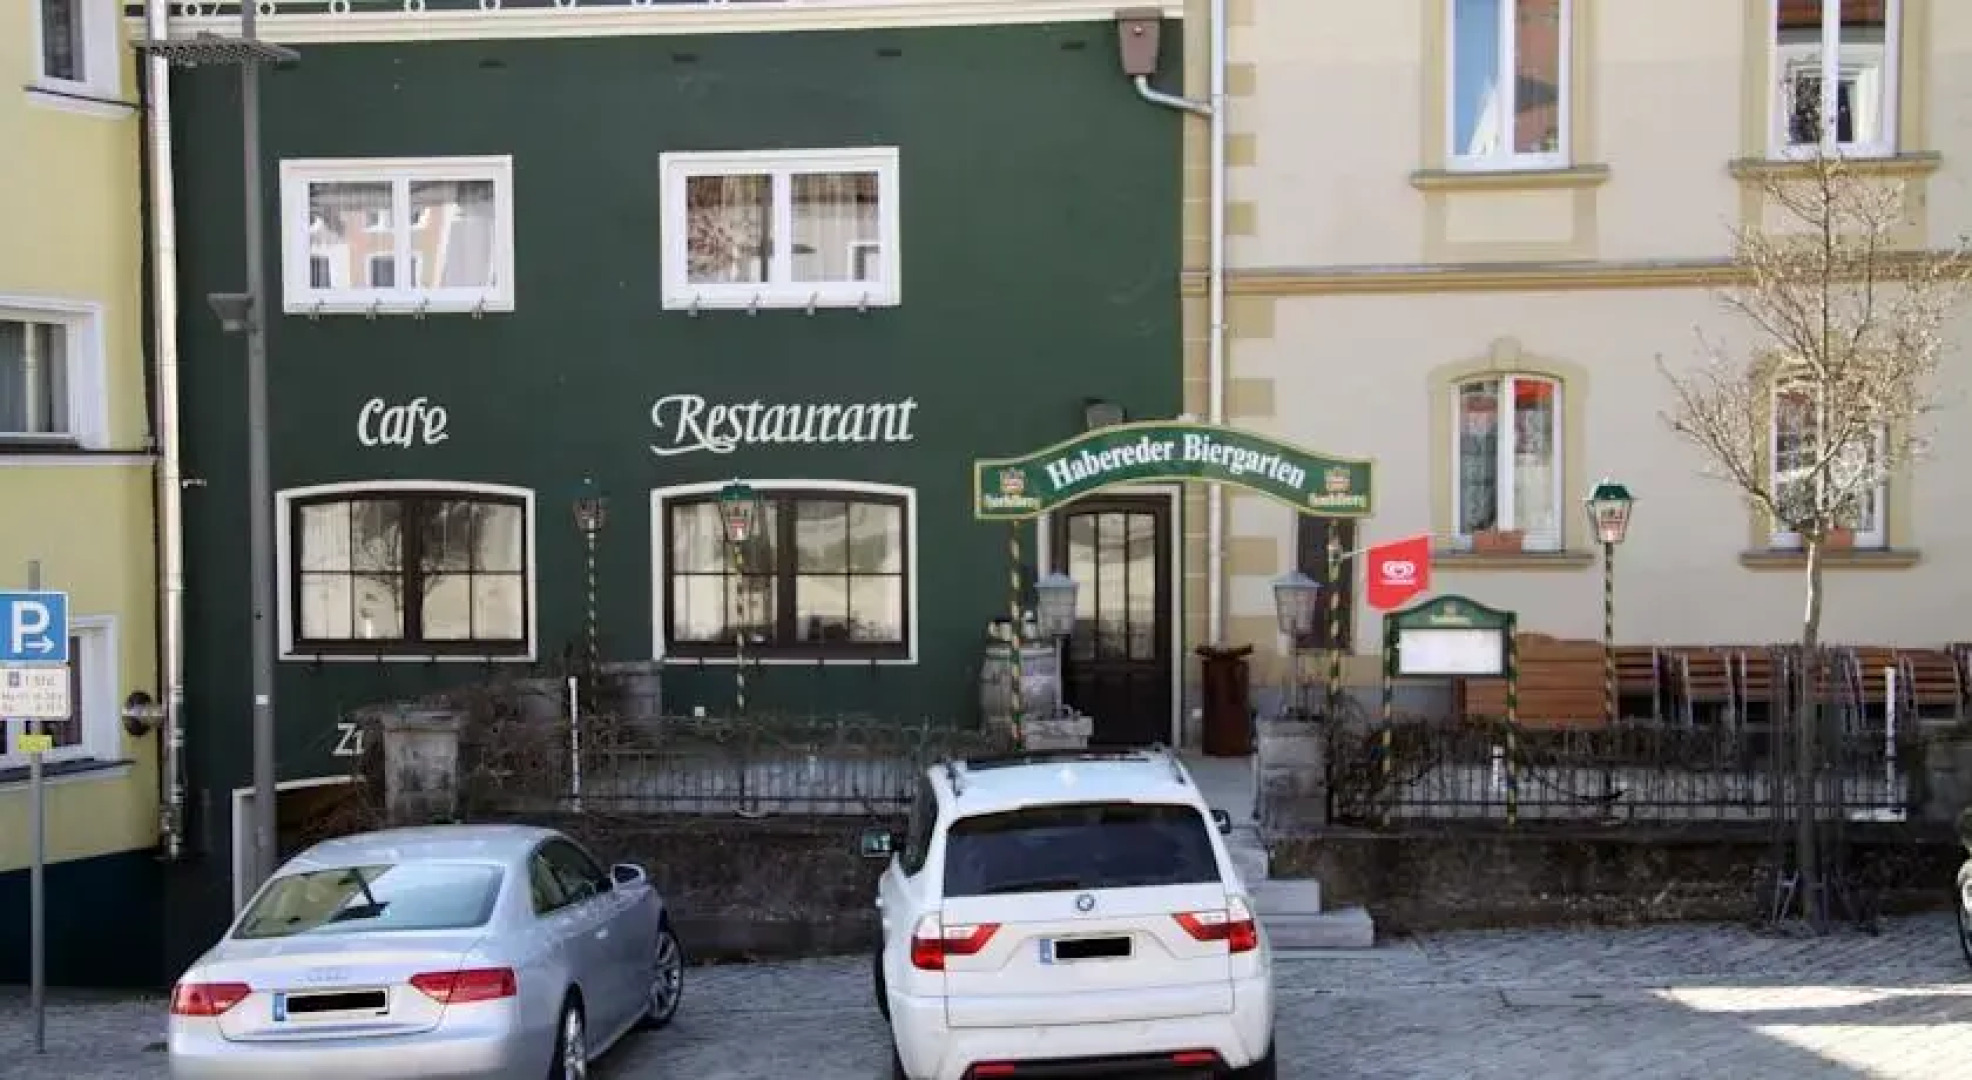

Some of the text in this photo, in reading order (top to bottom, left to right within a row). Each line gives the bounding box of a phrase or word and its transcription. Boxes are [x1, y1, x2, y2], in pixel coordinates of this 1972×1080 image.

[357, 397, 449, 449] Cafe
[650, 394, 918, 456] Restaurant
[1045, 433, 1305, 490] Habereder Biergarten
[12, 601, 49, 653] P
